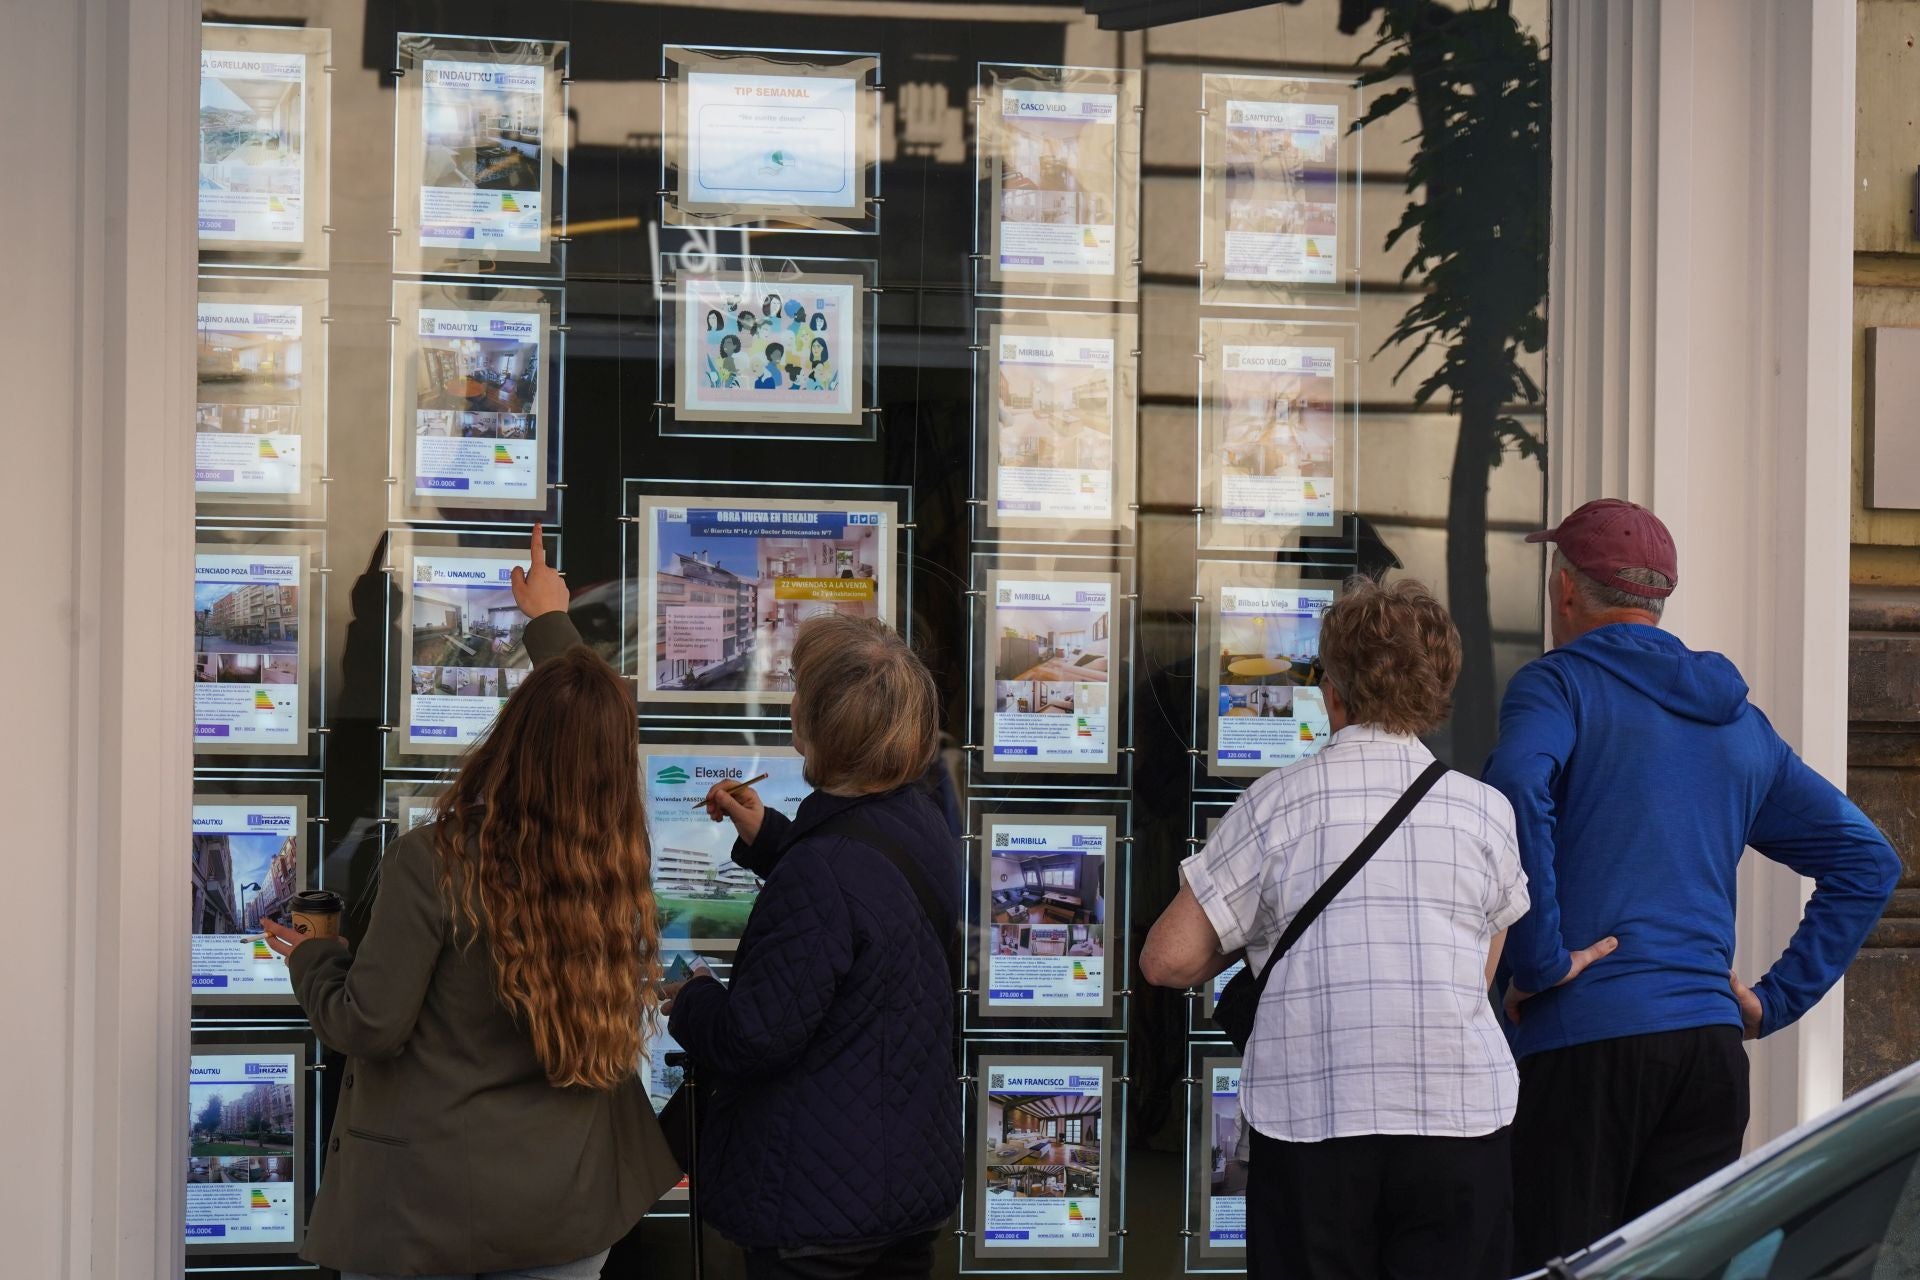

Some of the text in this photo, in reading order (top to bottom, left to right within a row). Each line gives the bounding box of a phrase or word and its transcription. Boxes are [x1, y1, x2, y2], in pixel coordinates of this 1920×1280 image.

[210, 60, 260, 70] GARELLANO
[439, 70, 492, 82] INDAUTXU
[734, 87, 810, 97] TIP SEMANAL
[1020, 102, 1066, 112] CASCO VIEJO
[438, 322, 478, 332] INDAUTXU
[1018, 349, 1054, 357] MIRIBILLA
[717, 511, 818, 524] OBRA NUEVA EN REKALDE
[434, 570, 486, 579] Plz. UNAMUNO
[1270, 600, 1288, 608] Vieja
[696, 766, 742, 778] Elexalde
[1011, 837, 1047, 845] MIRIBILLA
[1008, 1078, 1064, 1086] SAN FRANCISCO
